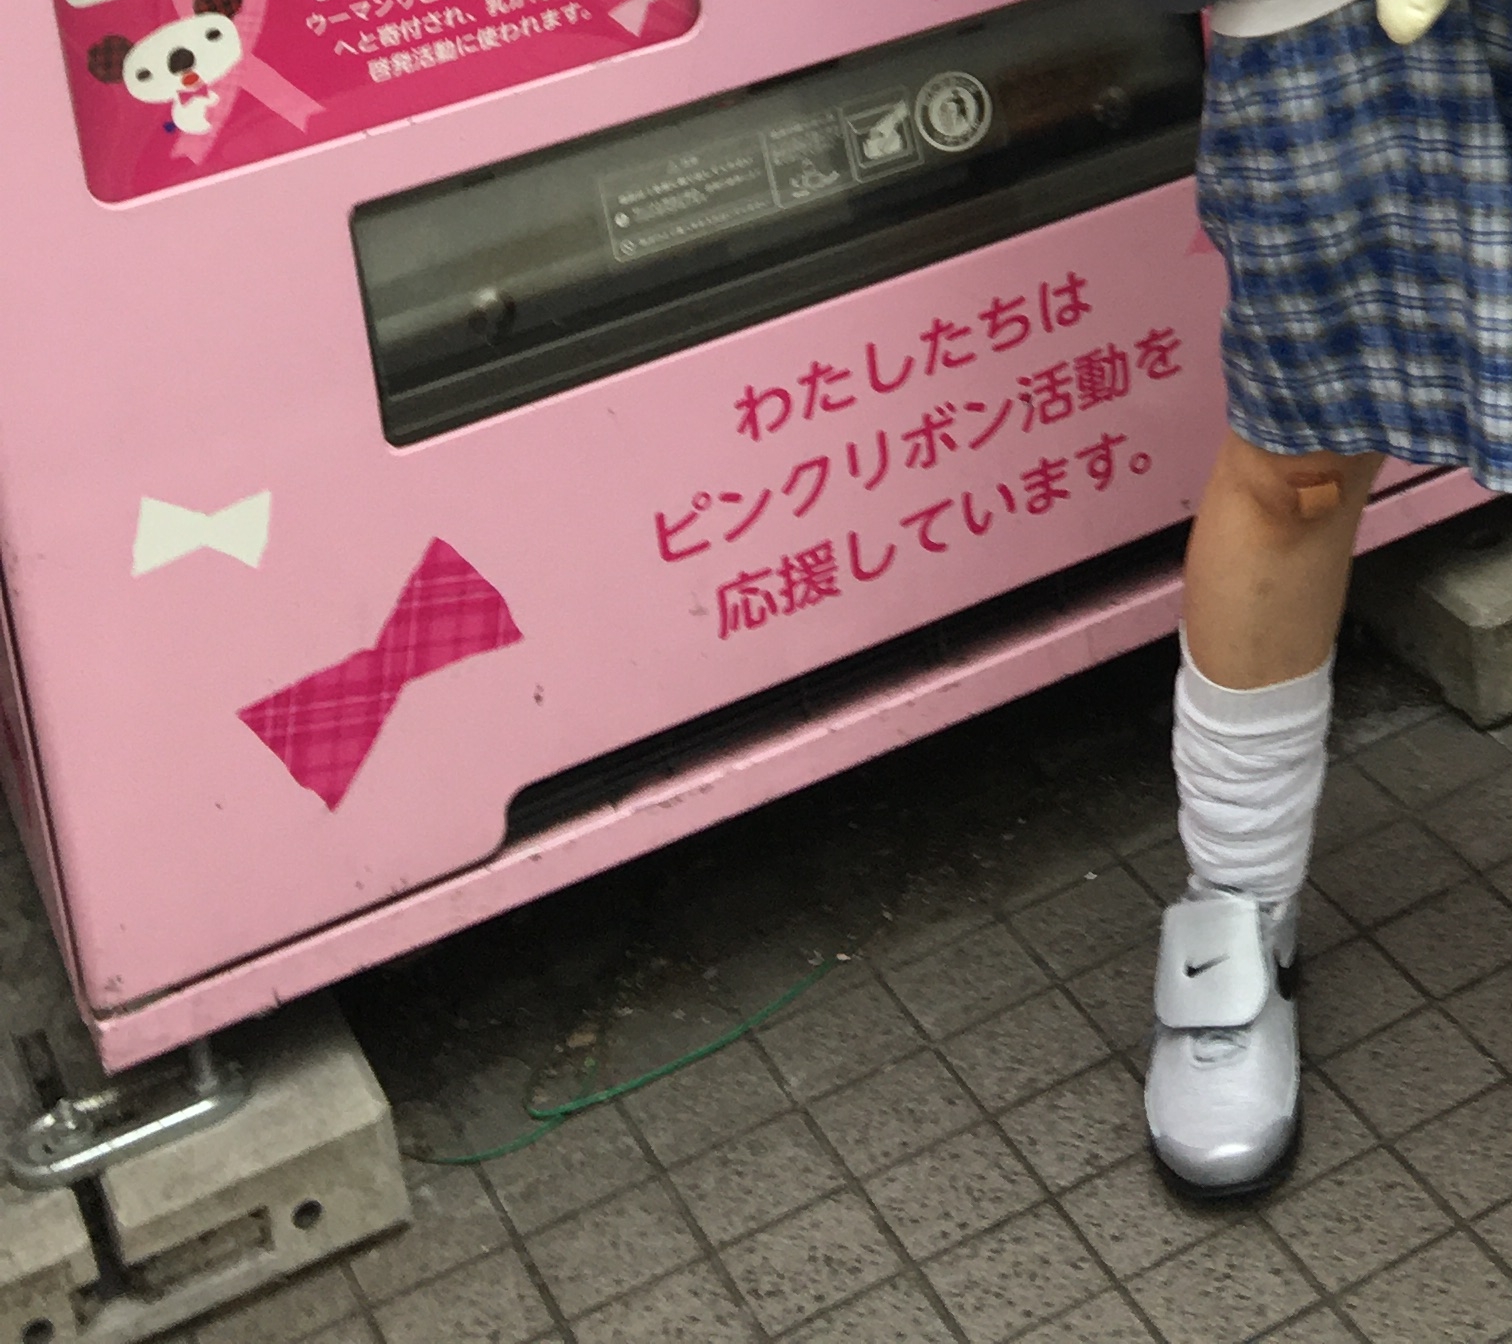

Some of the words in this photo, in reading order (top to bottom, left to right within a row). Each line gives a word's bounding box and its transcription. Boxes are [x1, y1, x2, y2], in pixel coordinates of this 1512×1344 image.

[653, 326, 1185, 565] ピンクリボン活動を
[734, 270, 1092, 444] わたしたちは
[716, 430, 1152, 640] 応援しています。
